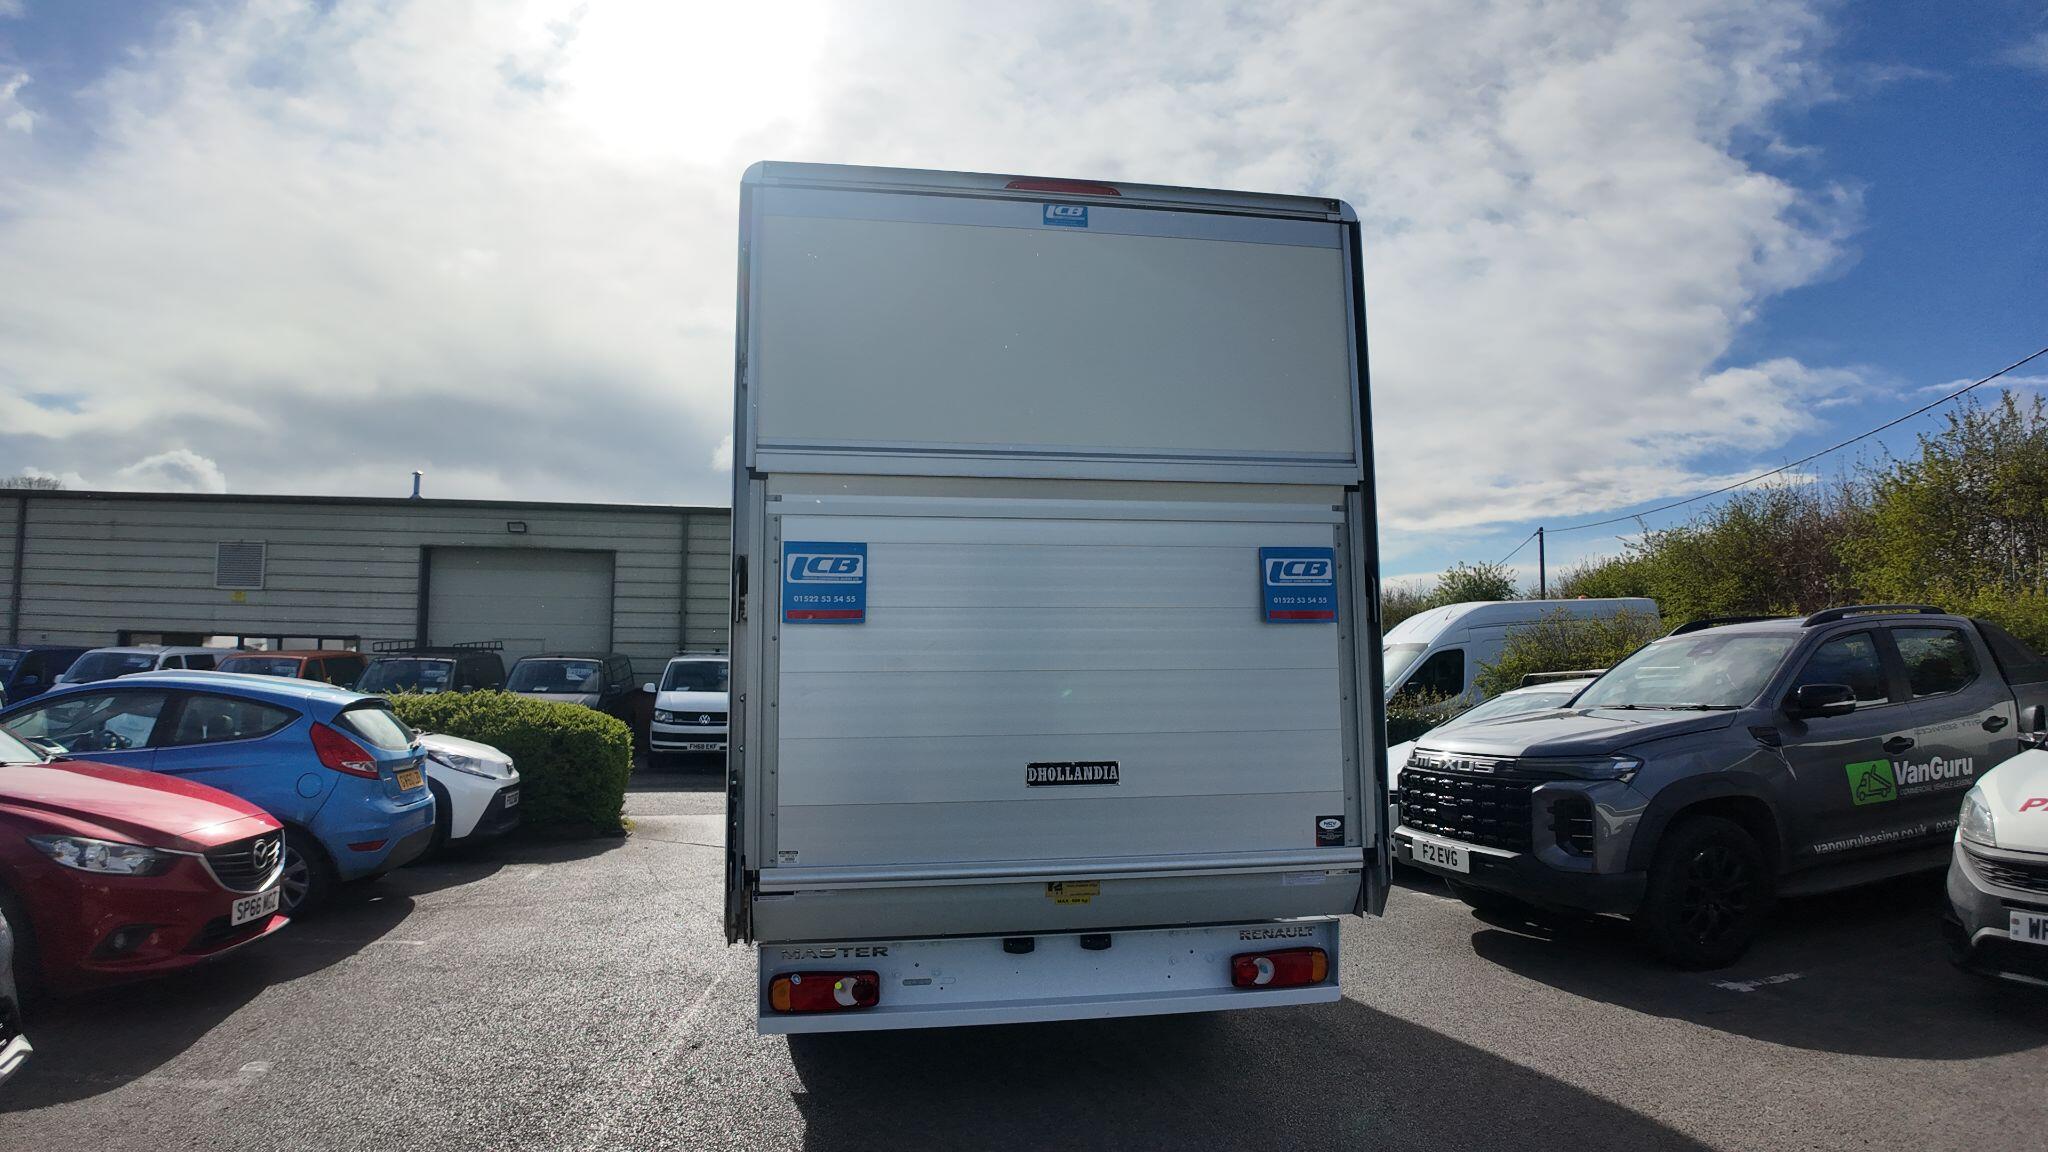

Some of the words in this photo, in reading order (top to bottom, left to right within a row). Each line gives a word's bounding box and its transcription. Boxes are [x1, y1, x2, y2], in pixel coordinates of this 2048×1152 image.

[790, 556, 860, 580] LCB
[1269, 561, 1329, 583] LCB
[793, 595, 819, 603] 01522
[821, 595, 832, 603] 53
[833, 595, 844, 603] 54
[846, 595, 857, 603] 55
[1027, 765, 1119, 782] DHOLLANDIA
[1893, 756, 1973, 786] VanGuru
[1422, 843, 1435, 861] F2
[1438, 847, 1457, 866] EVG
[237, 897, 261, 920] SP66
[1240, 926, 1315, 941] RENAULT
[781, 946, 889, 960] MASTER
